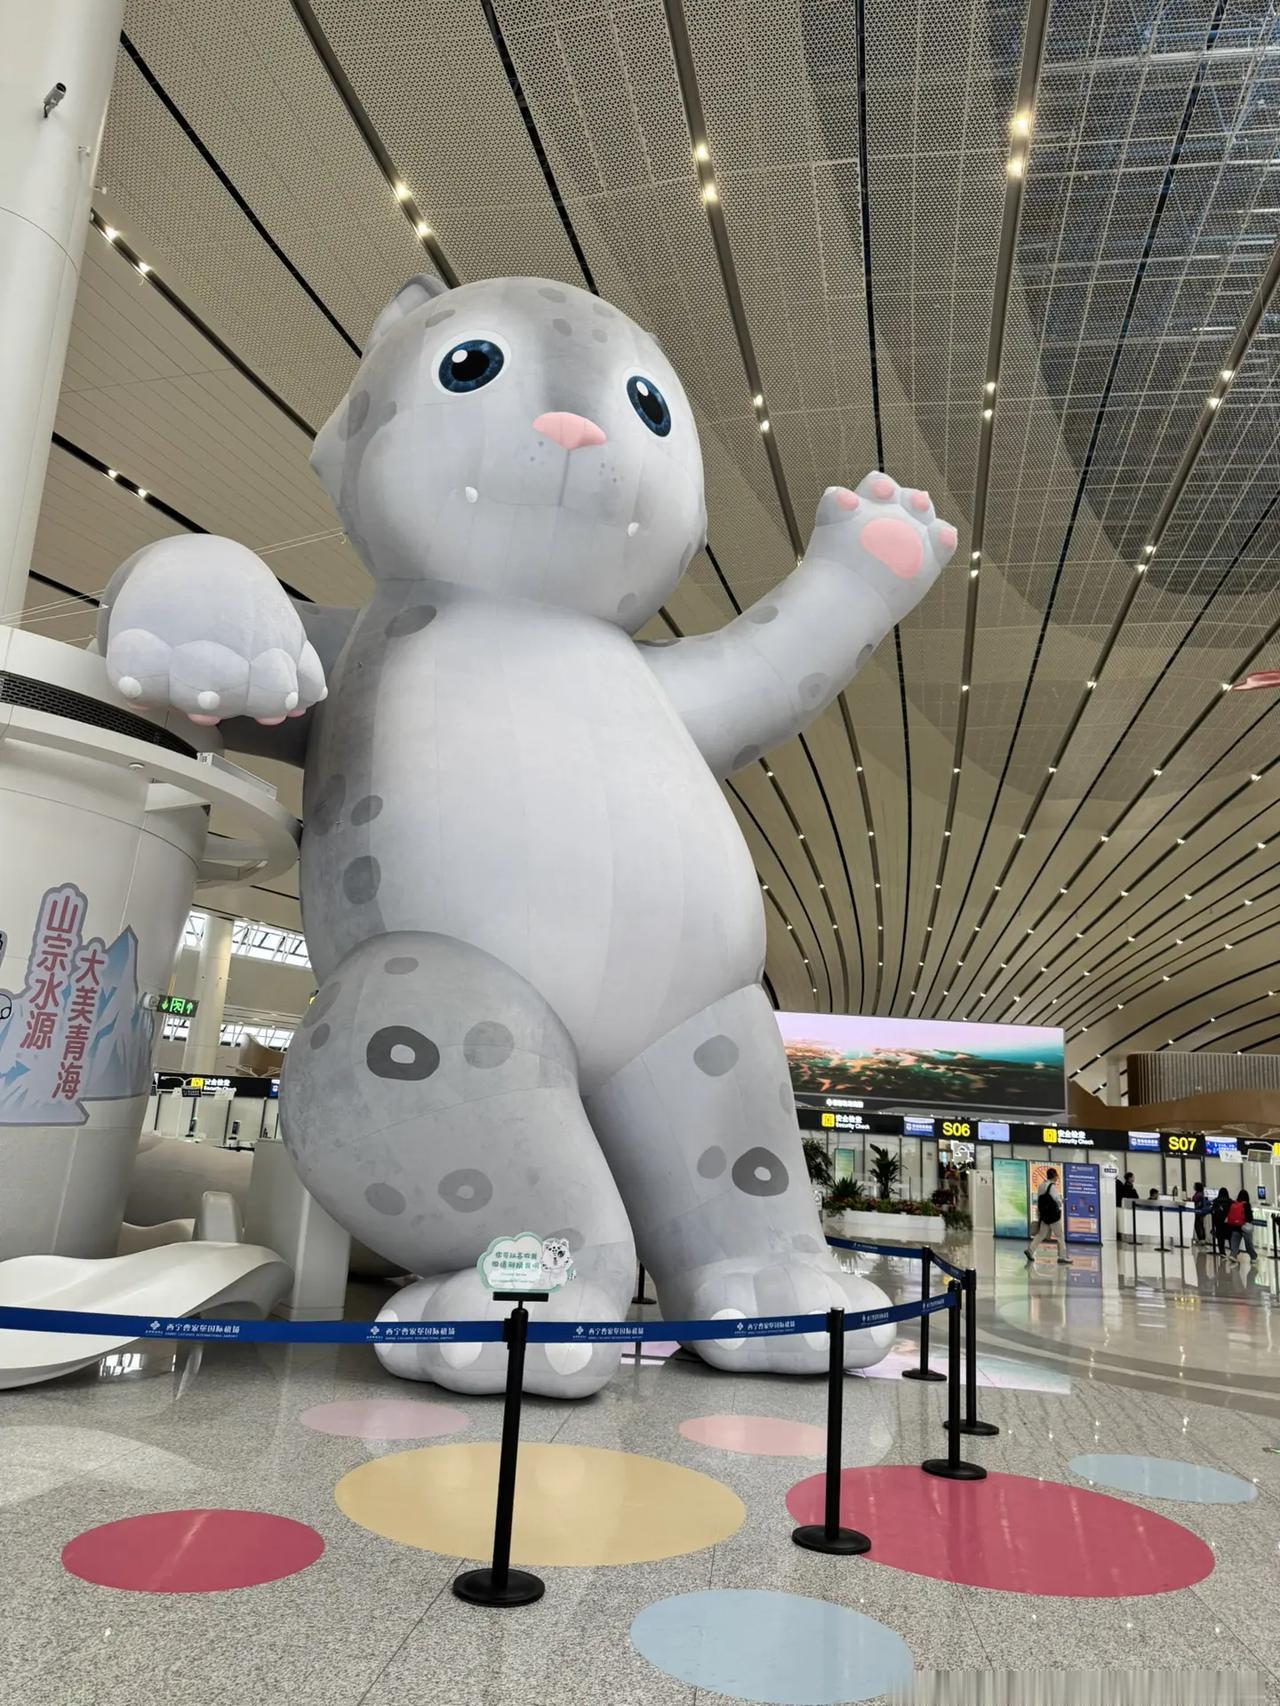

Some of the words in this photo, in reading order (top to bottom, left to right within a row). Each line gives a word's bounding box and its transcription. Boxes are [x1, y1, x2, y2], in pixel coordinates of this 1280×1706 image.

[20, 895, 79, 1050] 山宗水源
[51, 948, 105, 1100] 大美青海
[942, 1121, 971, 1137] S06
[1168, 1136, 1197, 1151] S07
